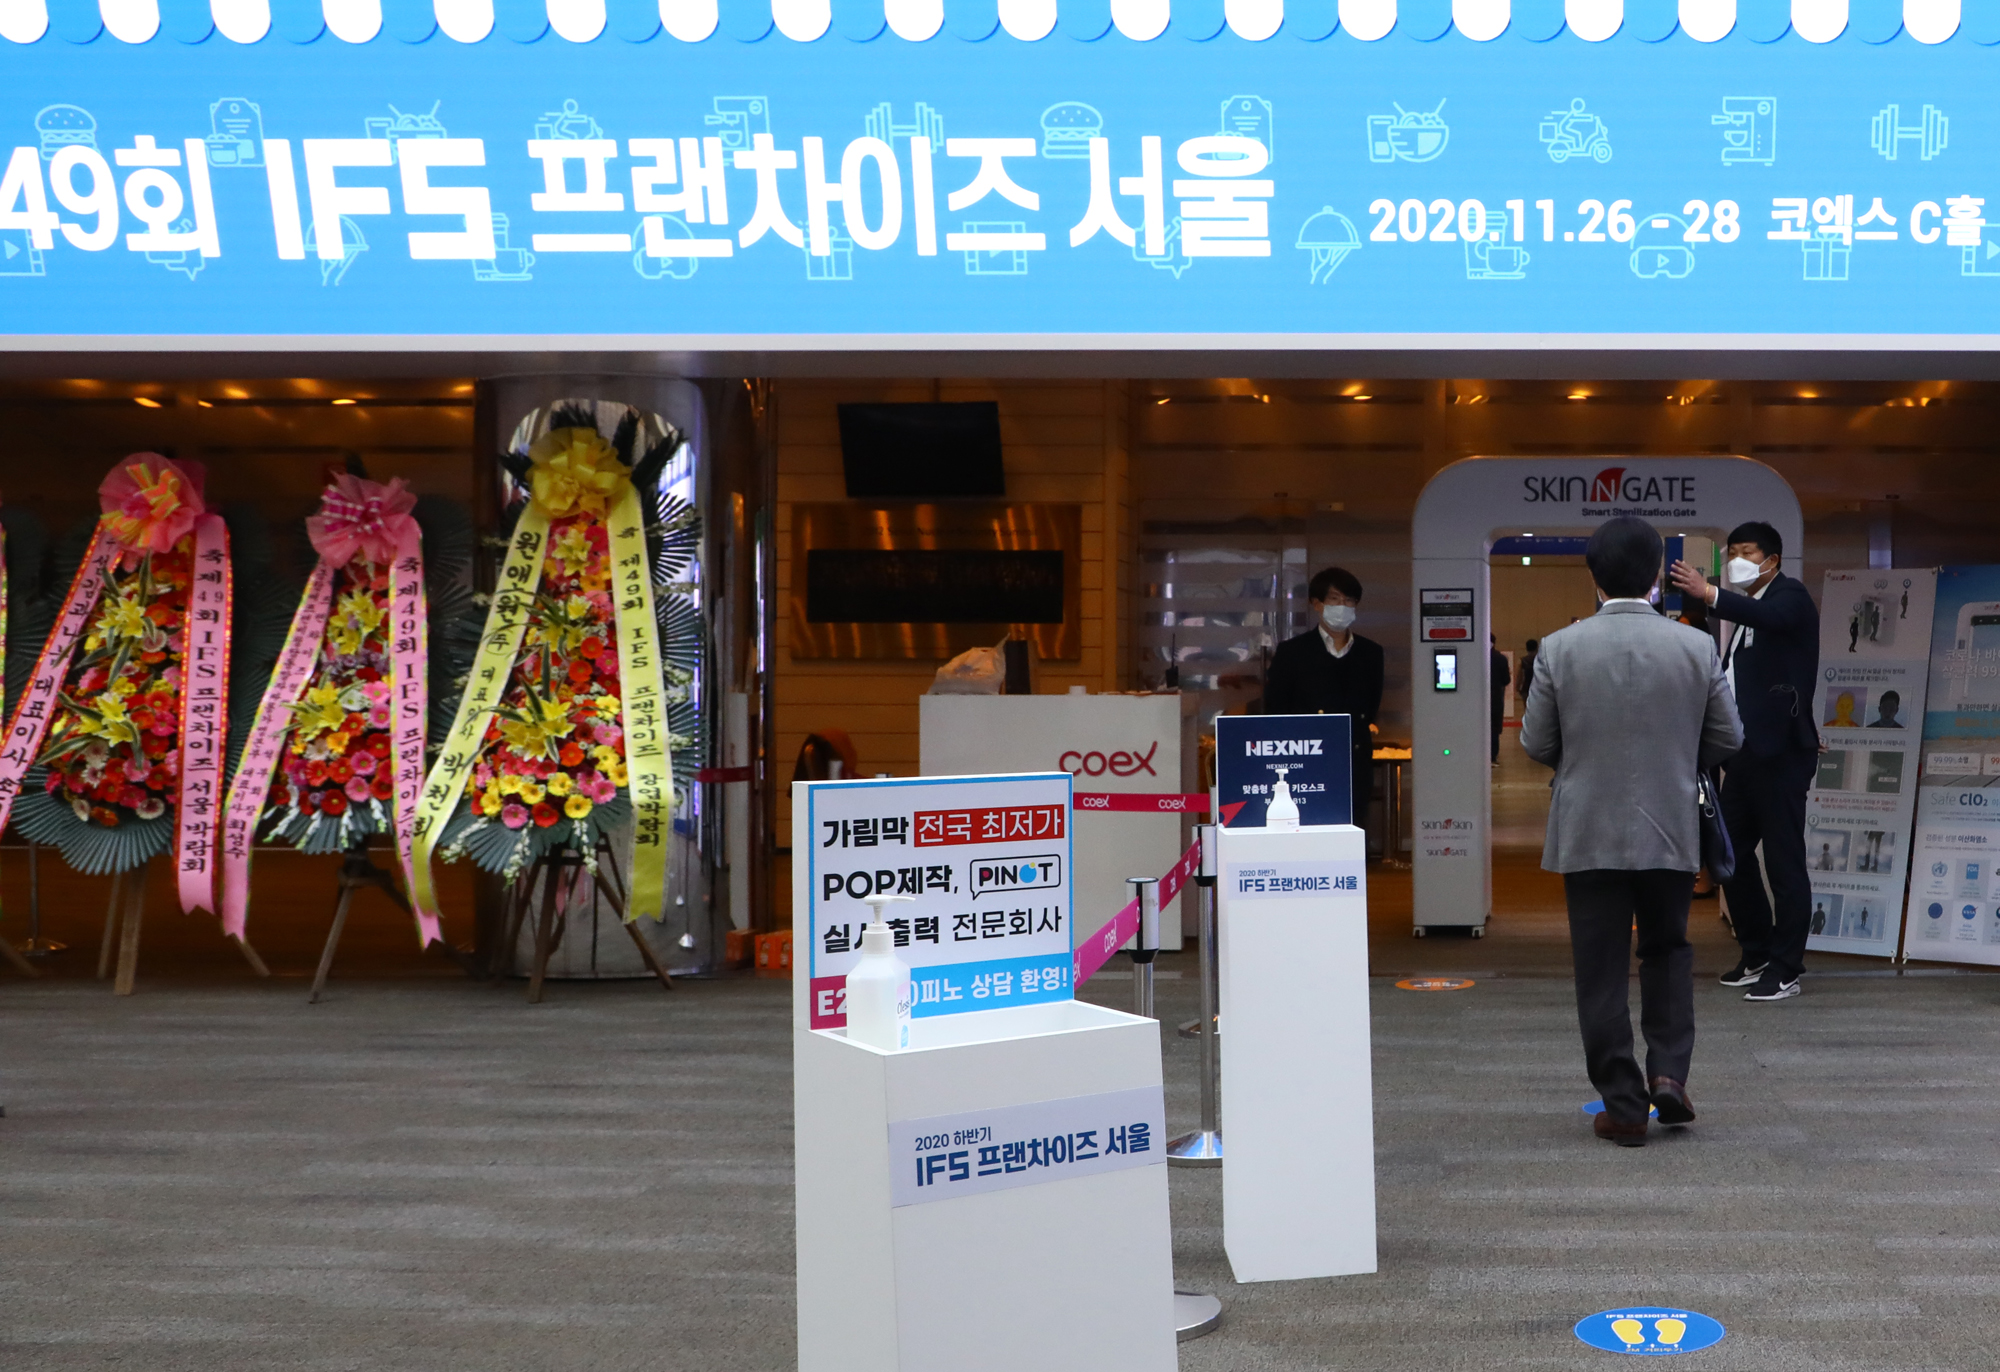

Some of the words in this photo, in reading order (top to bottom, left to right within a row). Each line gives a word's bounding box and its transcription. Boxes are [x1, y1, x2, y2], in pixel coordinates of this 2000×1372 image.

[0, 134, 221, 258] 49회
[262, 138, 497, 260] IFS
[527, 132, 1047, 258] 프랜차이즈
[1069, 134, 1276, 258] 서울
[1368, 197, 1636, 243] 2020.11.26
[1682, 198, 1742, 243] 28
[1766, 193, 1899, 246] 코엑스
[1581, 507, 1611, 517] Smart
[1673, 508, 1697, 517] Gate
[616, 526, 640, 540] 축
[201, 549, 225, 570] 축
[400, 556, 421, 574] 축
[617, 553, 645, 611] 제49회
[396, 580, 419, 655] 제49회
[195, 629, 221, 681] IFS
[631, 626, 649, 670] IFS
[1944, 648, 1982, 663] 코로나
[401, 662, 420, 720] IFS
[2, 674, 56, 769] 대표이사
[186, 686, 222, 773] 프랜차이즈
[629, 685, 664, 759] 프랜차이즈
[1058, 740, 1159, 778] coex
[1245, 739, 1324, 757] NEXNIZ
[184, 779, 215, 815] 서울
[411, 750, 467, 846] 박천희
[1082, 794, 1111, 809] coex
[1157, 795, 1187, 810] coex
[1242, 783, 1268, 796] 맞춤형
[1291, 783, 1326, 794] 키오스크
[1930, 792, 1957, 807] Safe
[823, 816, 910, 849] 가림막
[917, 810, 974, 845] 전국
[981, 807, 1063, 840] 최저가
[180, 821, 213, 875] 박람회
[822, 864, 960, 902] POP제작,
[1238, 869, 1257, 878] 2020
[1256, 868, 1277, 878] 하반기
[1238, 878, 1266, 893] IFS
[1268, 876, 1331, 893] 프랜차이즈
[1332, 875, 1359, 891] 서울
[952, 905, 1063, 943] 전문회사
[970, 971, 1014, 1000] 상담
[1020, 965, 1069, 994] 환영!
[914, 1133, 951, 1152] 2020
[952, 1126, 993, 1147] 하반기
[915, 1150, 971, 1188] IFS
[976, 1130, 1100, 1178] 프랜차이즈
[1104, 1122, 1152, 1156] 서울
